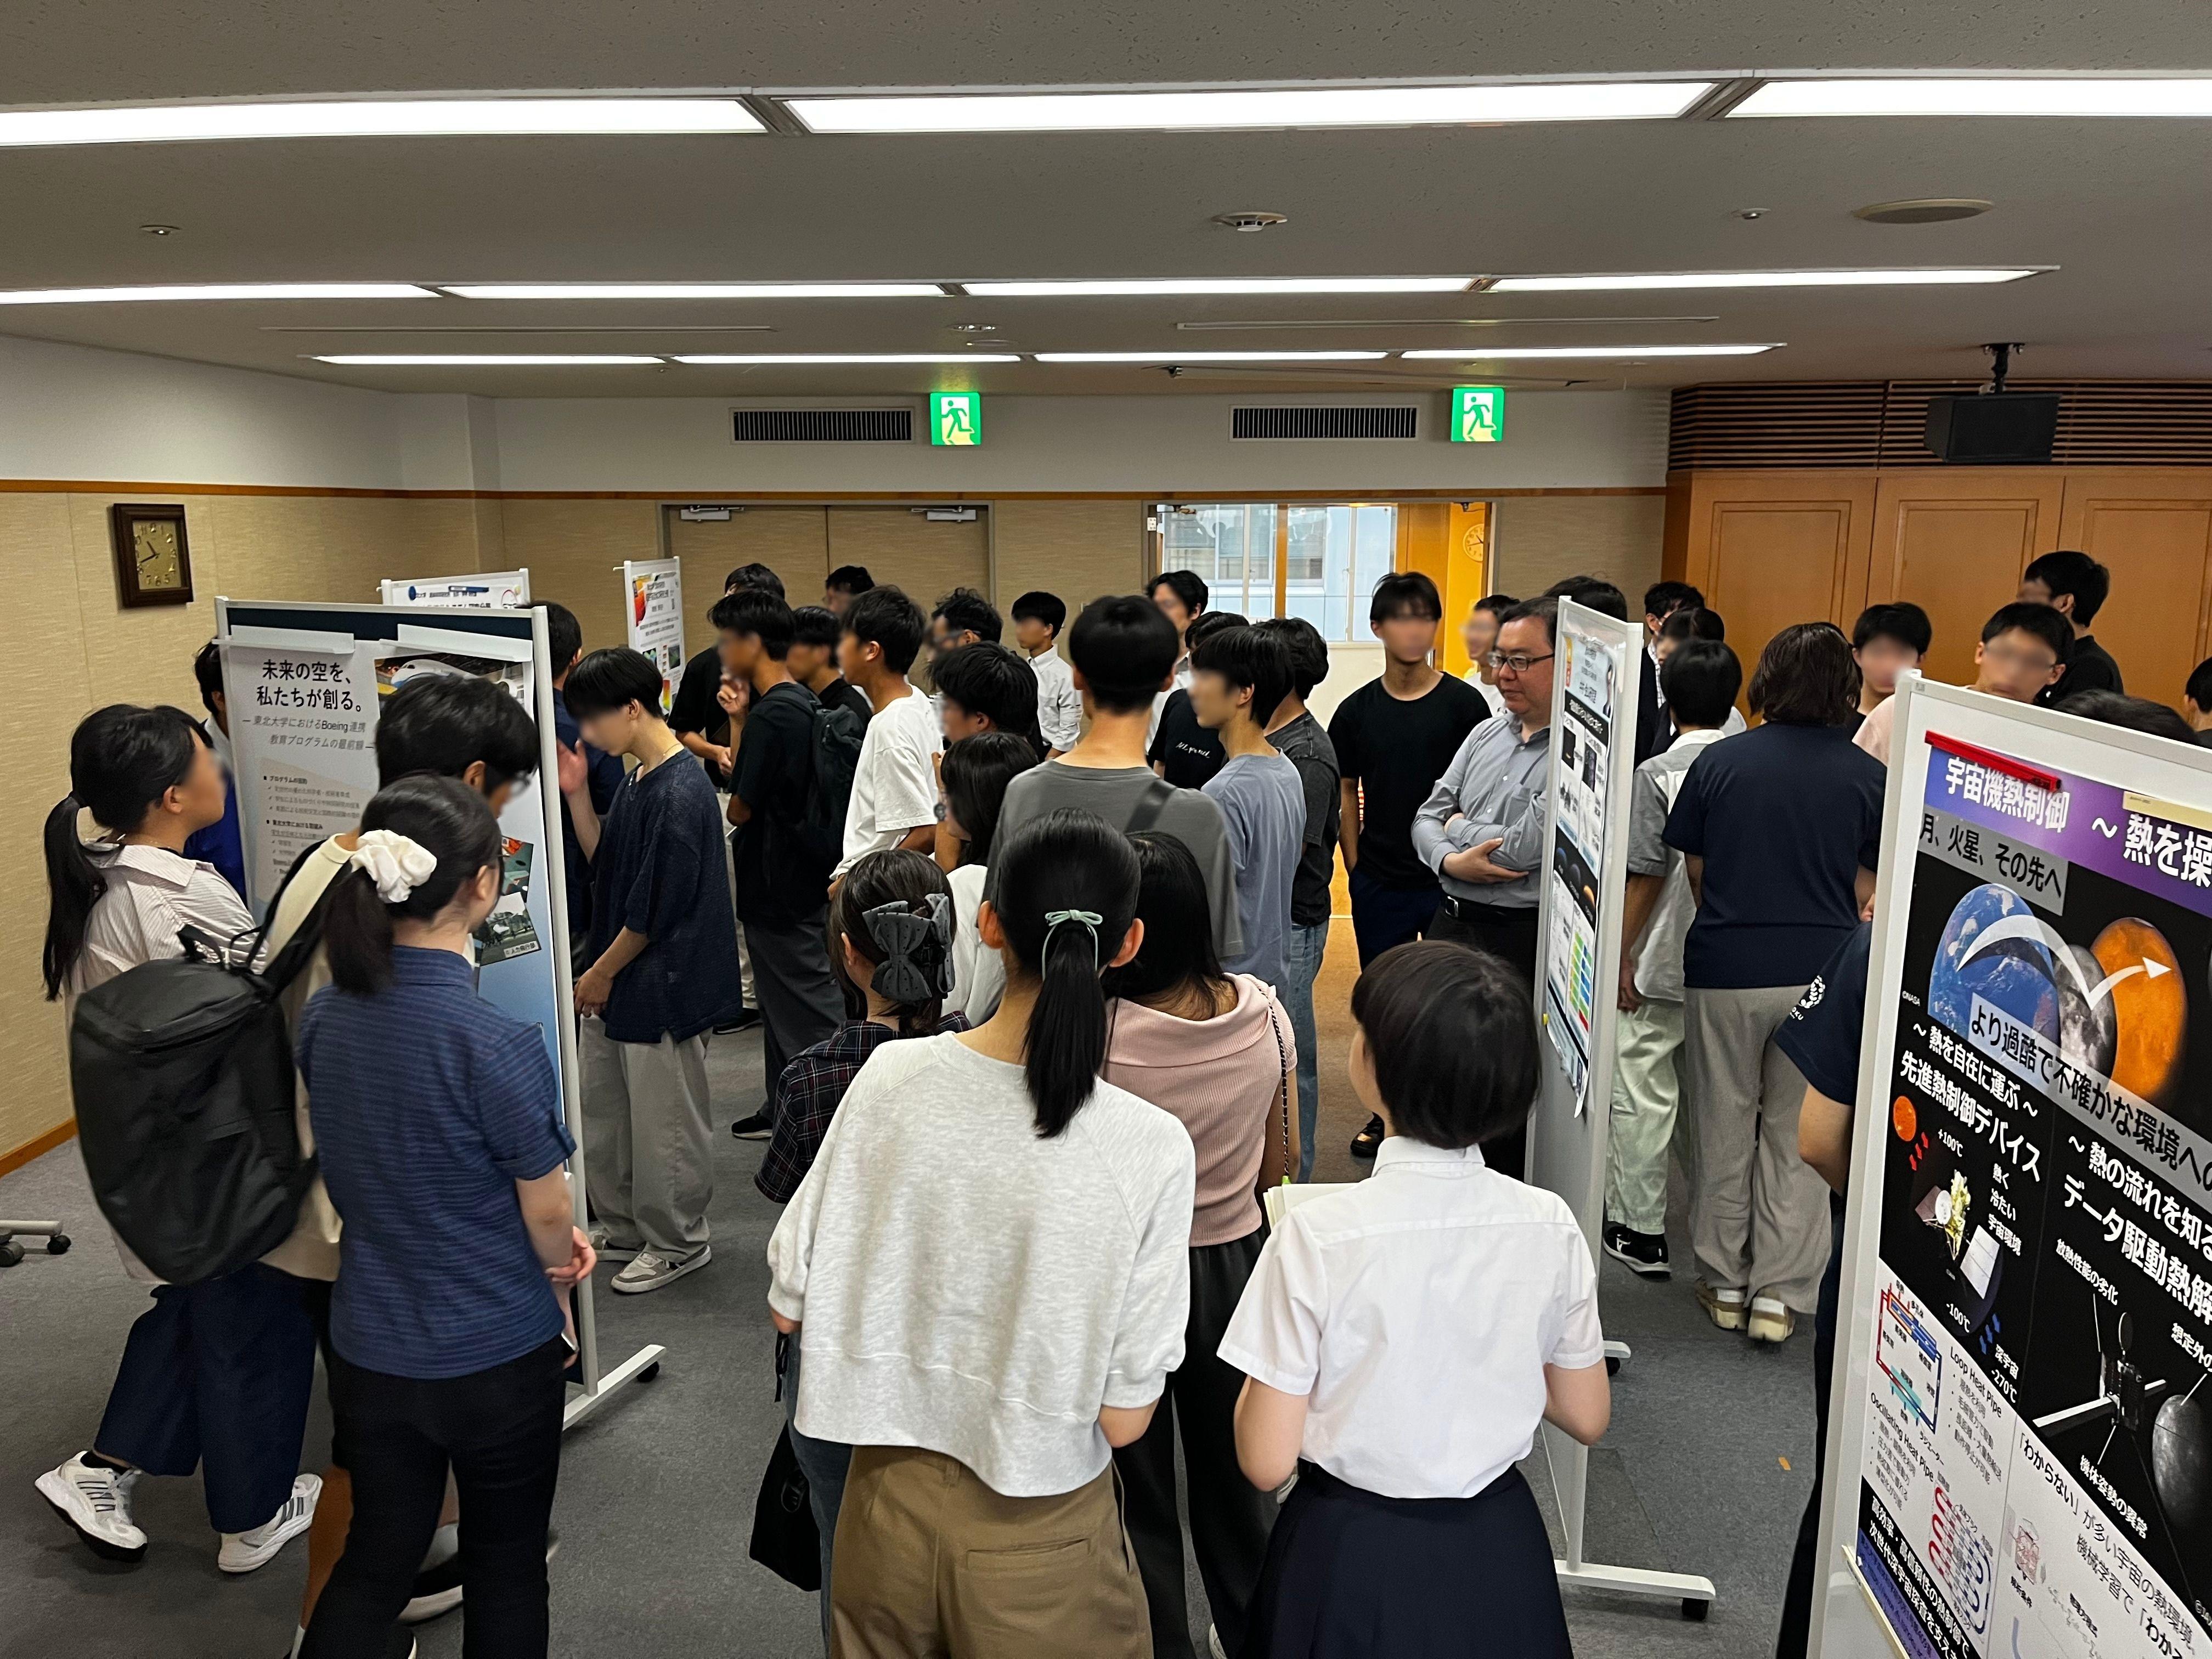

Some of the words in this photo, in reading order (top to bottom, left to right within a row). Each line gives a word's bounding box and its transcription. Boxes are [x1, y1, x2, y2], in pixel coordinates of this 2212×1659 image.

[257, 685, 361, 712] 私たちが創る。
[262, 659, 351, 684] 未来の空を、
[1946, 757, 2070, 833] 宇宙機熱制御
[1920, 813, 2061, 898] 月、火星、その先へ
[1929, 1026, 2021, 1110] 熱を自在に運ぶ
[1900, 1050, 2040, 1182] 先進熱制御デバイス
[1988, 1214, 2022, 1256] 宇宙環境
[2056, 1238, 2118, 1305] 放熱性能の劣化
[1951, 1346, 1968, 1374] Loop
[1970, 1368, 1985, 1397] Heat
[1987, 1390, 2001, 1418] Pipe
[1871, 1392, 1903, 1441] Oscillating
[1904, 1434, 1918, 1462] Heat
[1920, 1456, 1933, 1482] Pipe
[2079, 1455, 2148, 1539] 機体姿勢の異常
